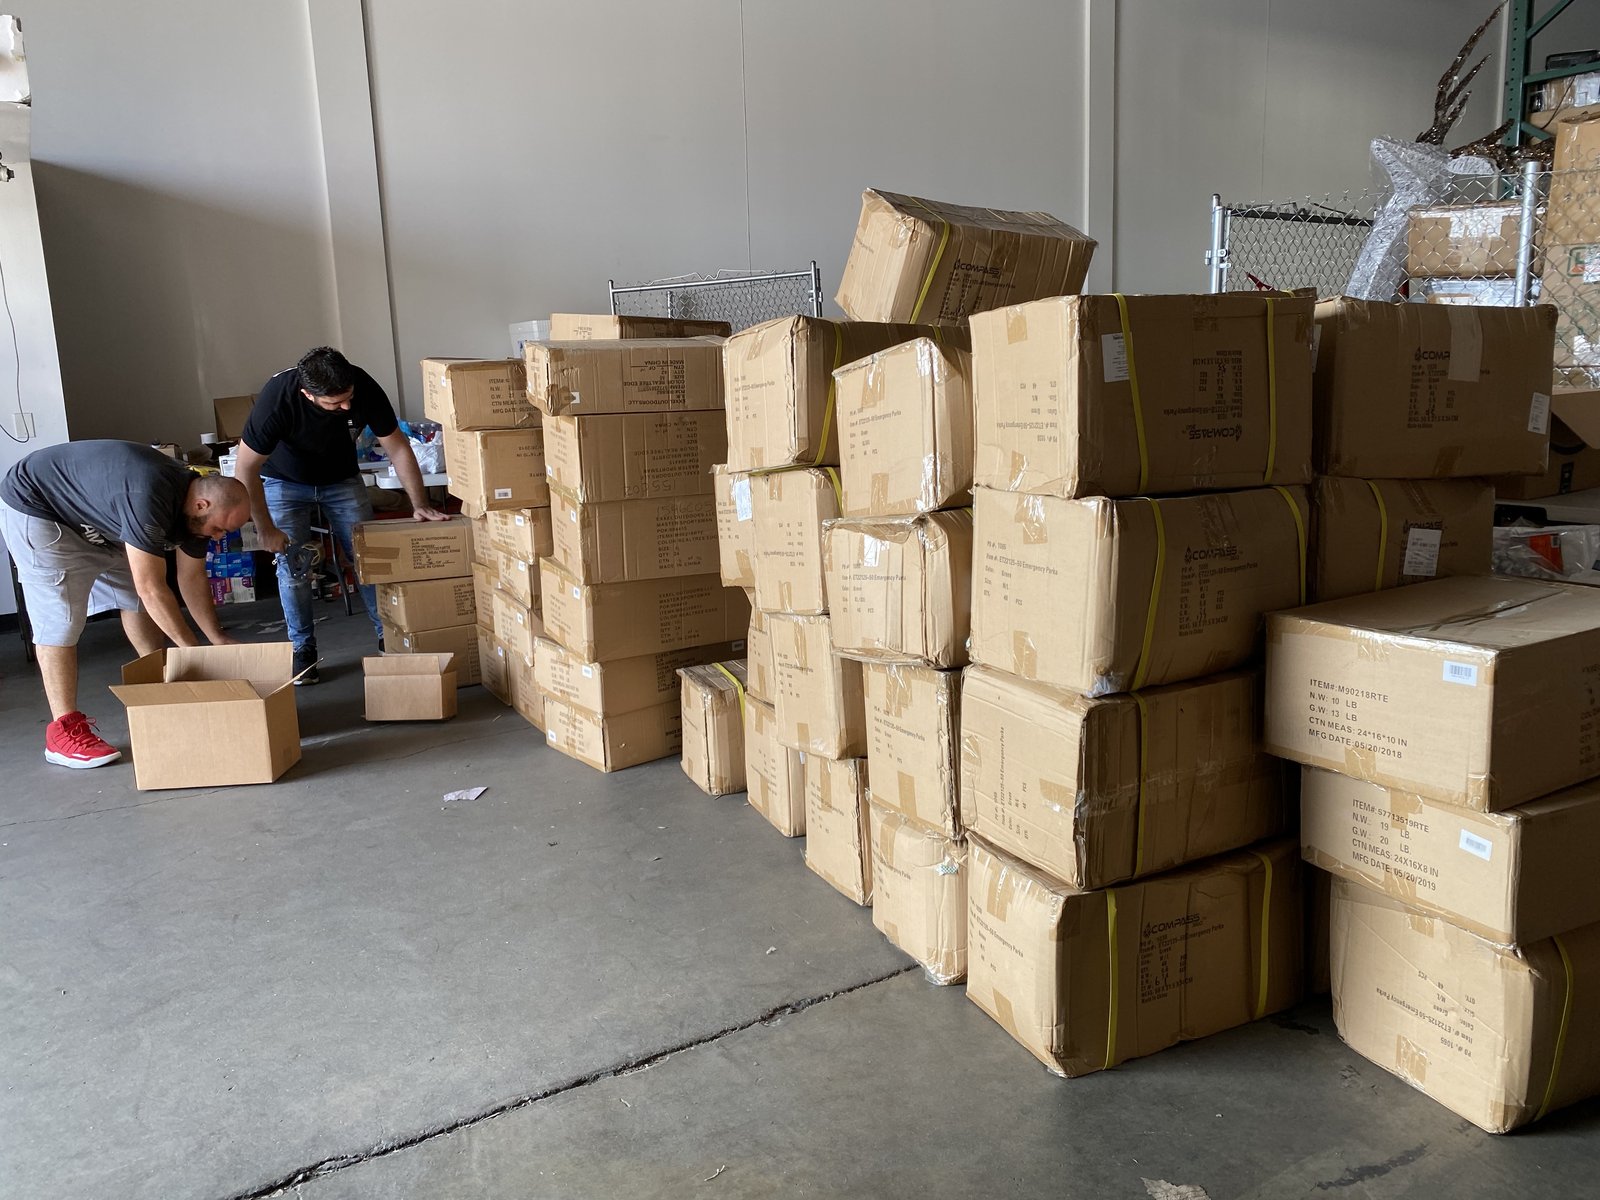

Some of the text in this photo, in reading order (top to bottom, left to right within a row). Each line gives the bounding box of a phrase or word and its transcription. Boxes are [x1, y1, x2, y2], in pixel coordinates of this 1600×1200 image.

[1423, 351, 1450, 360] COMP
[1189, 428, 1235, 439] COMPASS
[1346, 700, 1357, 709] LB
[1332, 710, 1340, 718] 13
[1346, 713, 1357, 722] LB
[1309, 717, 1326, 727] CTN
[1328, 721, 1355, 734] MEAS:
[1398, 738, 1408, 747] IN
[1309, 729, 1327, 740] MFG
[1381, 822, 1389, 831] 19
[1380, 836, 1389, 845] 20
[1352, 839, 1439, 878] CTN MEAS: 24X16X8 IN
[1352, 852, 1436, 891] MFG DATE: 05/20/2019
[1152, 913, 1200, 935] COMPASS
[1376, 988, 1390, 1000] Parka
[1391, 994, 1419, 1015] Emergency
